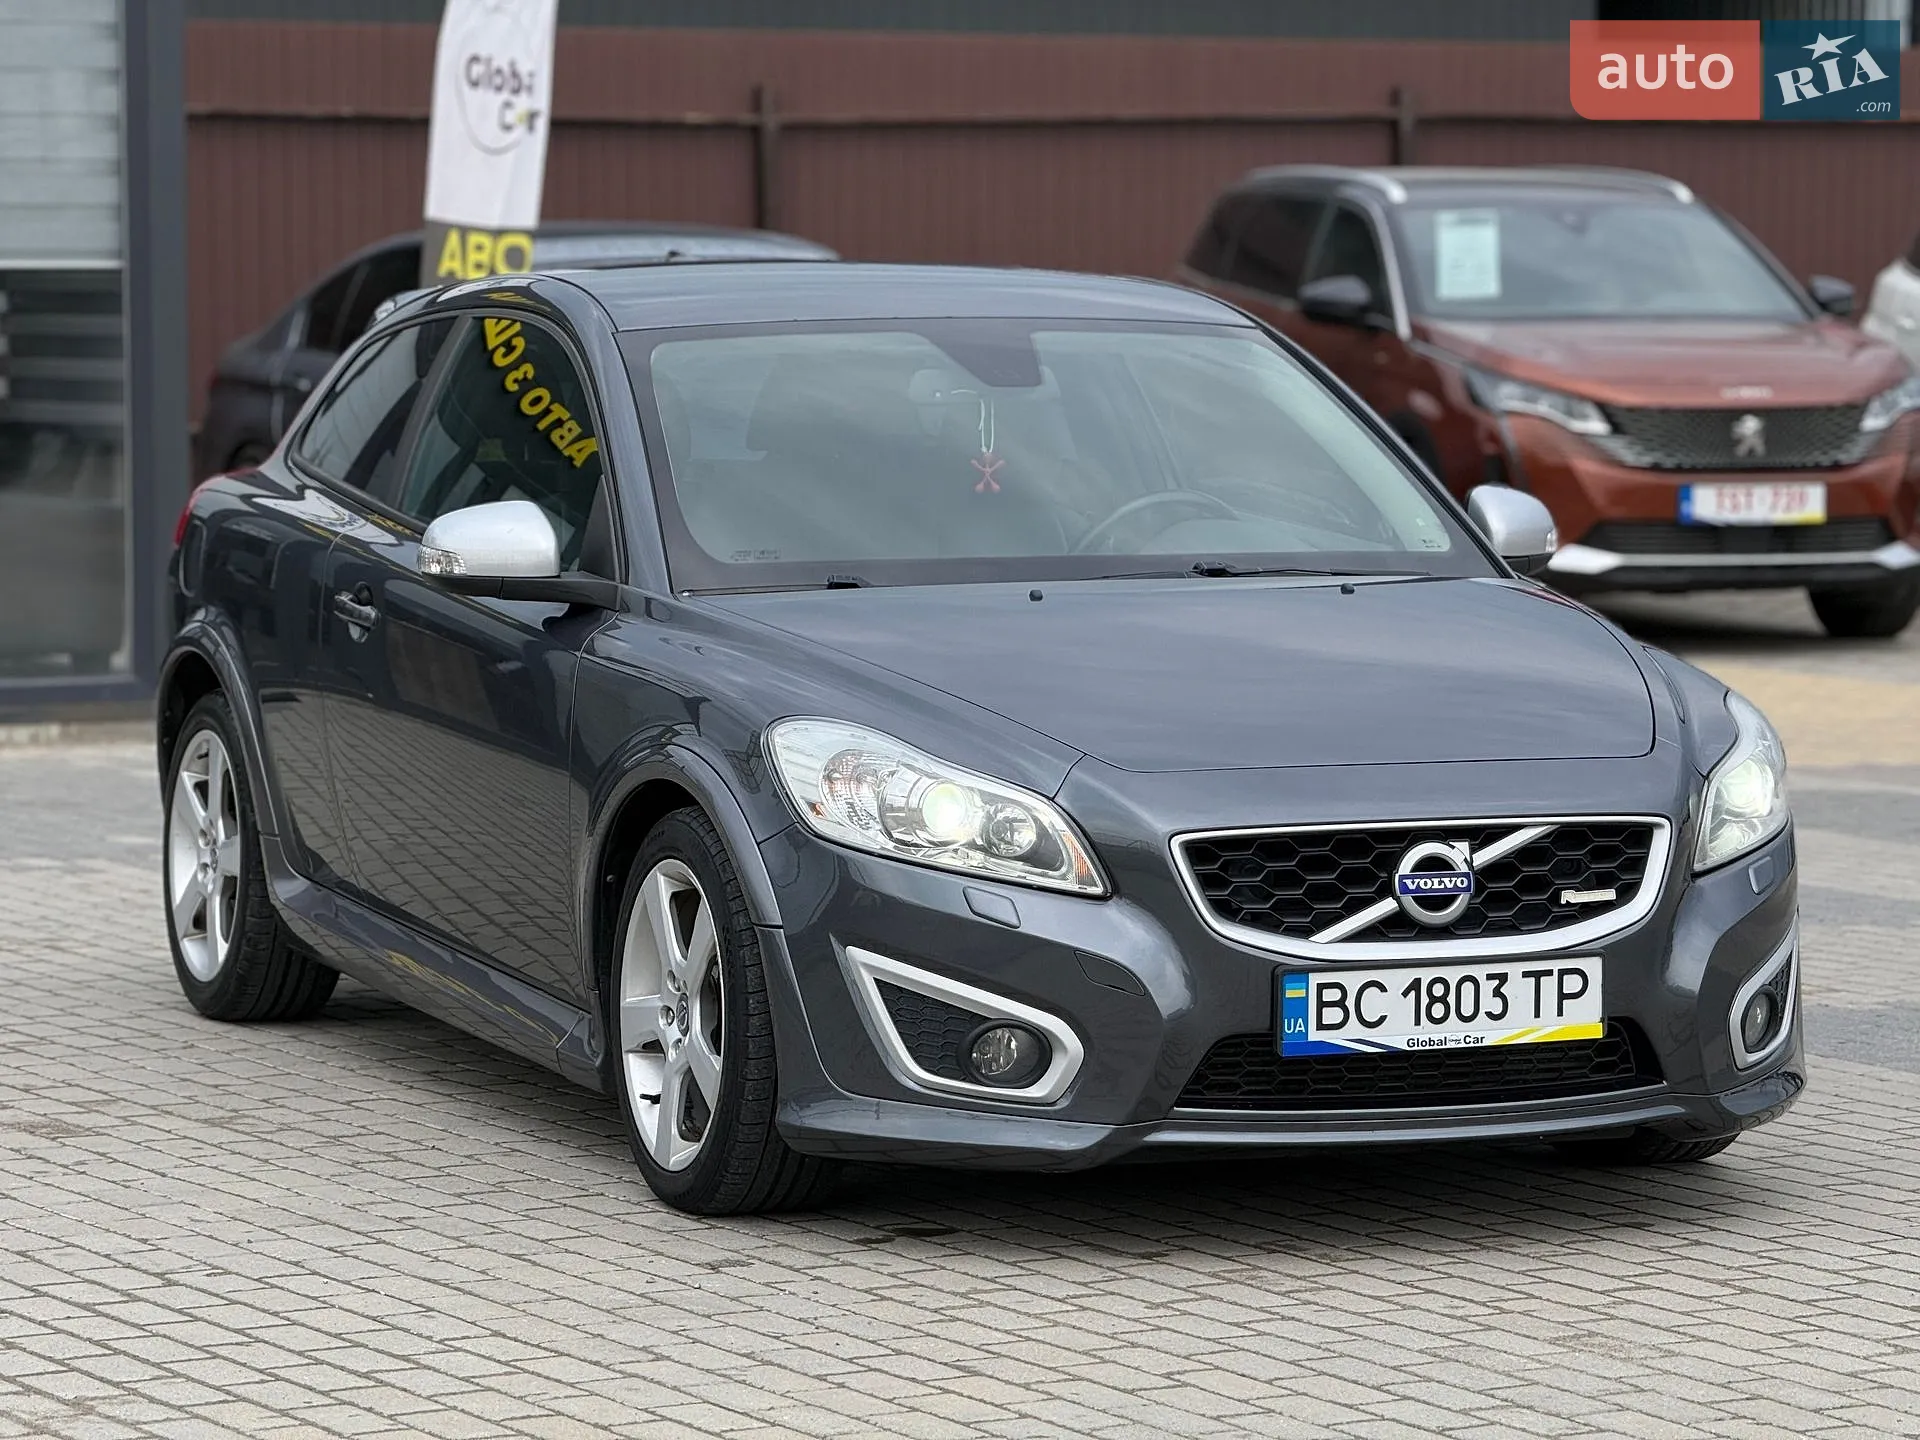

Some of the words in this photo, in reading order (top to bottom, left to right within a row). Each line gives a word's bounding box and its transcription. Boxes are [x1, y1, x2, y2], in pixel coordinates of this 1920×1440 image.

[1402, 877, 1469, 890] VOLVO
[1315, 979, 1389, 1032] BC
[1400, 972, 1509, 1027] 1803
[1521, 967, 1590, 1020] TP
[1284, 1017, 1306, 1034] UA
[1406, 1036, 1448, 1048] Global
[1463, 1034, 1486, 1045] Car
